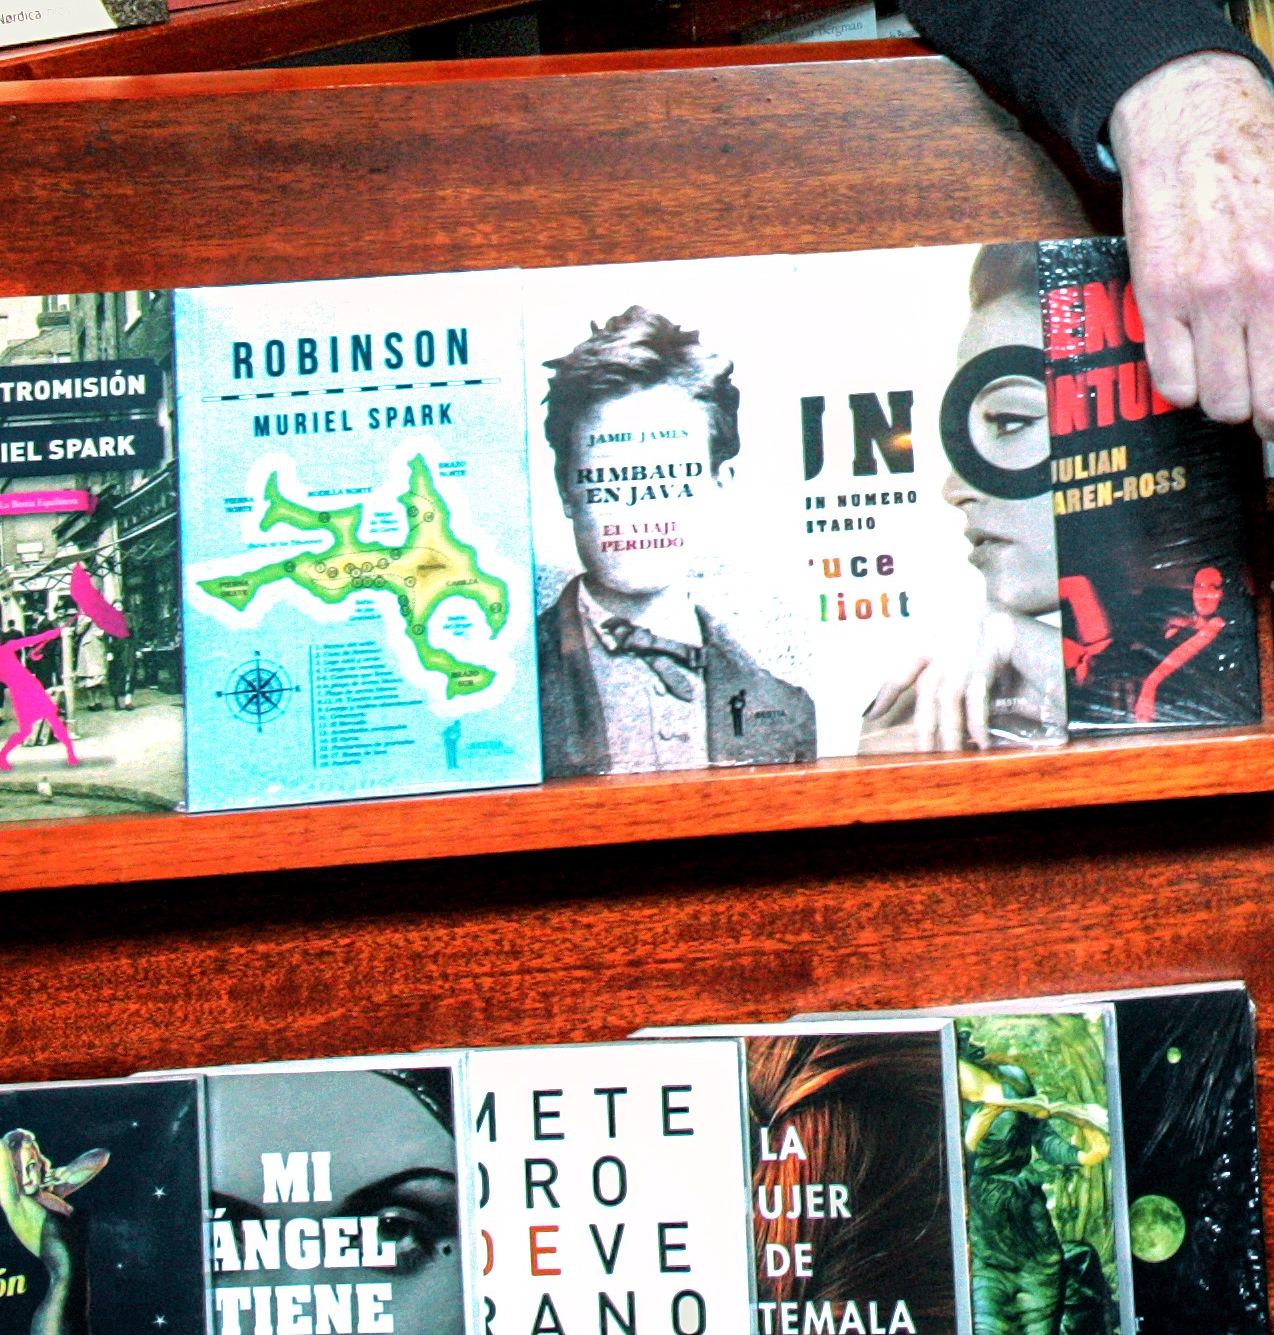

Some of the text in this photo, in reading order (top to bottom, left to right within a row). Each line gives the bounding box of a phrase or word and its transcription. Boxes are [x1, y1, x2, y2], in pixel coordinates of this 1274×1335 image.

[233, 327, 470, 380] ROBINSON
[0, 368, 146, 403] TROMISIÓN
[253, 402, 453, 438] MURIEL SPARK
[586, 428, 689, 447] JAMIE JAMES
[0, 435, 136, 463] IEL SPARK
[576, 460, 704, 486] RIMBAUD
[12, 498, 35, 509] Bestia
[37, 496, 78, 510] Equilátera
[584, 481, 694, 508] EN JAVA
[837, 490, 918, 509] NÚMERO
[1054, 467, 1187, 516] AREN-ROSS
[599, 535, 686, 554] PERDIDO
[600, 520, 680, 540] EL VIAJE
[808, 554, 895, 579] uce
[819, 590, 910, 622] liott
[760, 1125, 807, 1161] LA
[260, 1151, 333, 1204] MI
[479, 1154, 628, 1209] RO
[758, 1183, 852, 1220] UJER
[209, 1208, 396, 1271] ÁNGEL
[766, 1242, 813, 1278] DE
[216, 1282, 395, 1334] TIENE
[758, 1298, 917, 1335] TEMALA
